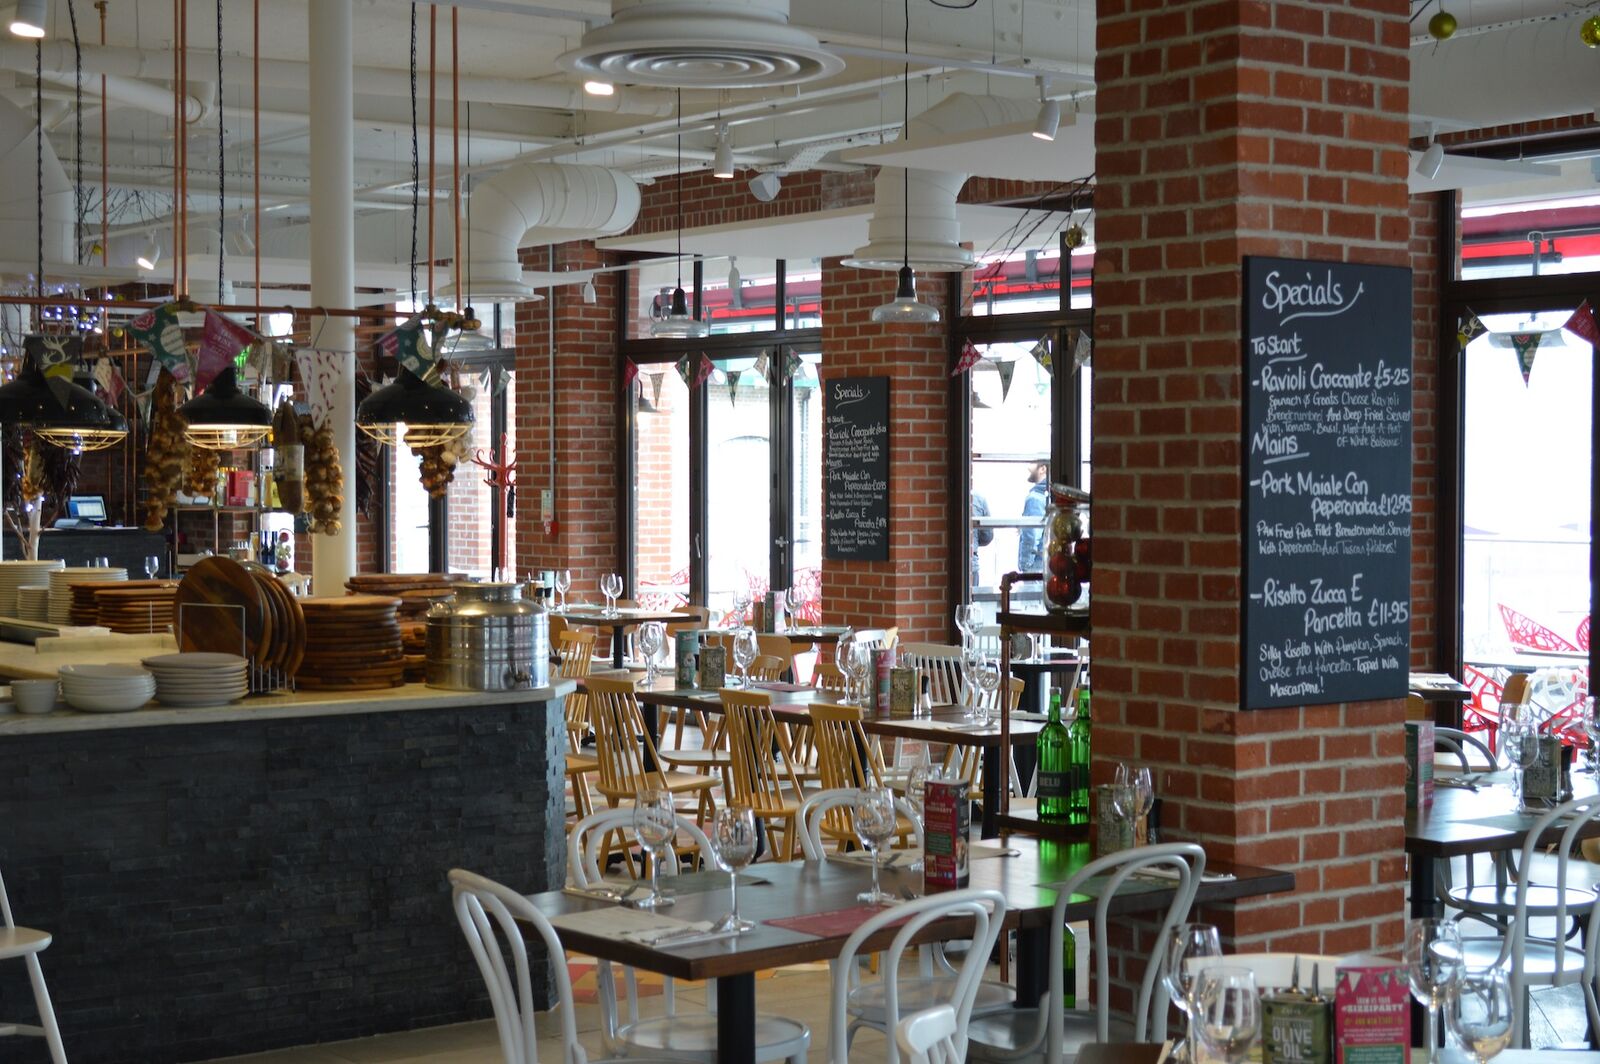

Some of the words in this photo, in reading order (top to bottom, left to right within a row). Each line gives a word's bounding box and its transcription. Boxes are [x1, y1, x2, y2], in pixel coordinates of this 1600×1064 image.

[1263, 269, 1343, 313] Specials
[1251, 337, 1265, 355] To
[1267, 332, 1302, 355] Start
[1262, 365, 1306, 392] Ravioli
[1310, 363, 1372, 389] Croccante
[834, 384, 863, 400] Specials
[1251, 432, 1298, 456] Mains
[1262, 470, 1295, 498] Pork
[1297, 471, 1343, 496] Maiale
[1345, 471, 1369, 495] Con
[1311, 496, 1378, 522] Peperonata
[1264, 578, 1306, 607] Risotto
[1310, 578, 1347, 604] Zucca
[1304, 606, 1362, 636] Pancetta
[1259, 643, 1281, 668] Silky
[1314, 640, 1334, 655] With
[1259, 664, 1291, 682] Cheese
[1382, 654, 1399, 669] With
[1273, 1026, 1312, 1045] OLIVE
[1283, 1043, 1303, 1059] OIL
